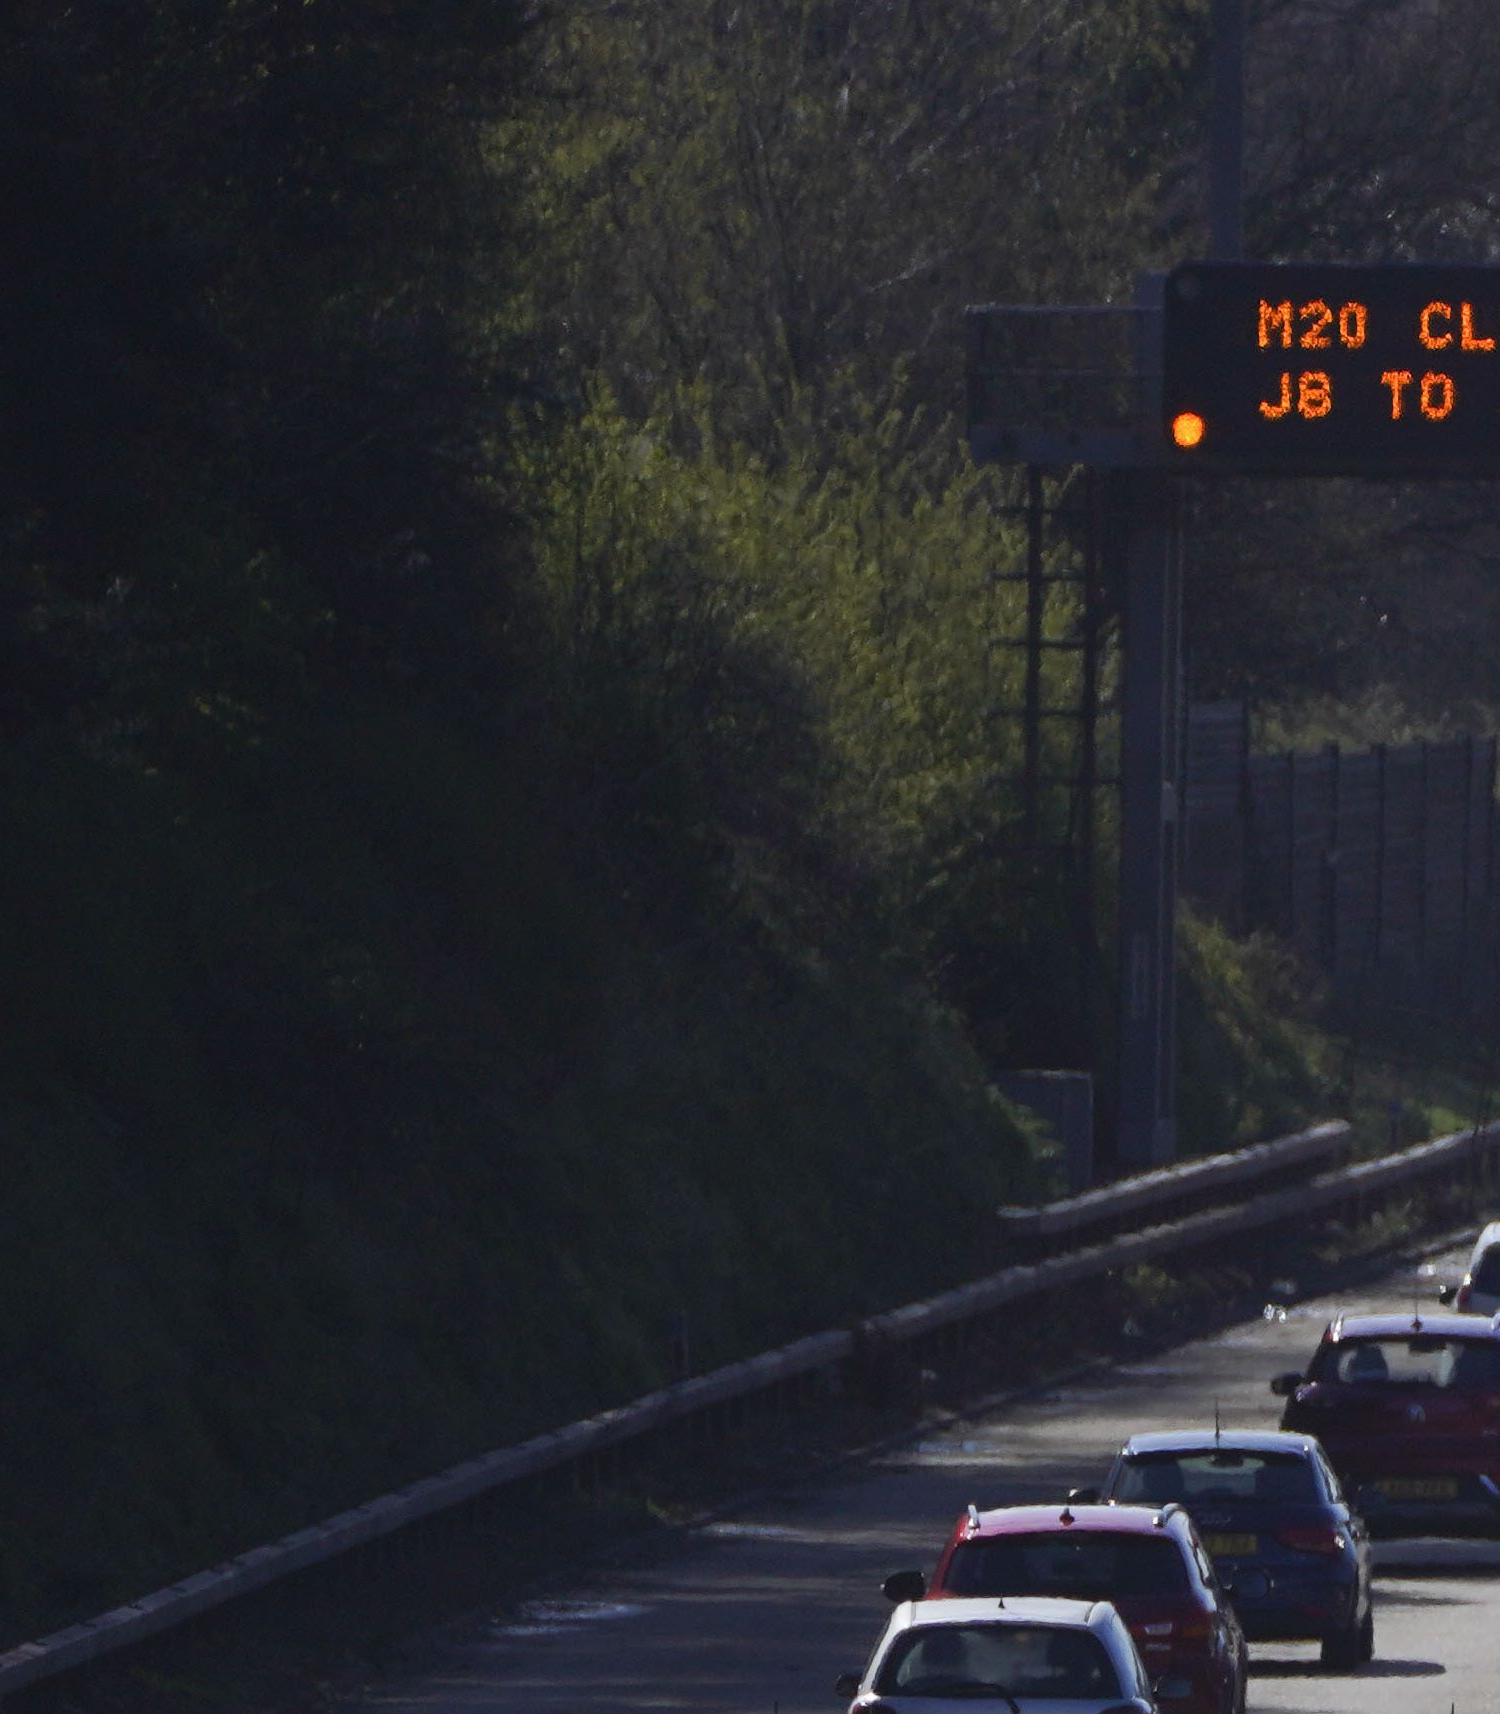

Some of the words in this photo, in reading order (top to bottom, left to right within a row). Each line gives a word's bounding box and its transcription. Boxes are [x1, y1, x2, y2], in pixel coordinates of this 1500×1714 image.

[1258, 300, 1368, 351] M20
[1259, 371, 1331, 420] J8
[1381, 371, 1455, 420] TO
